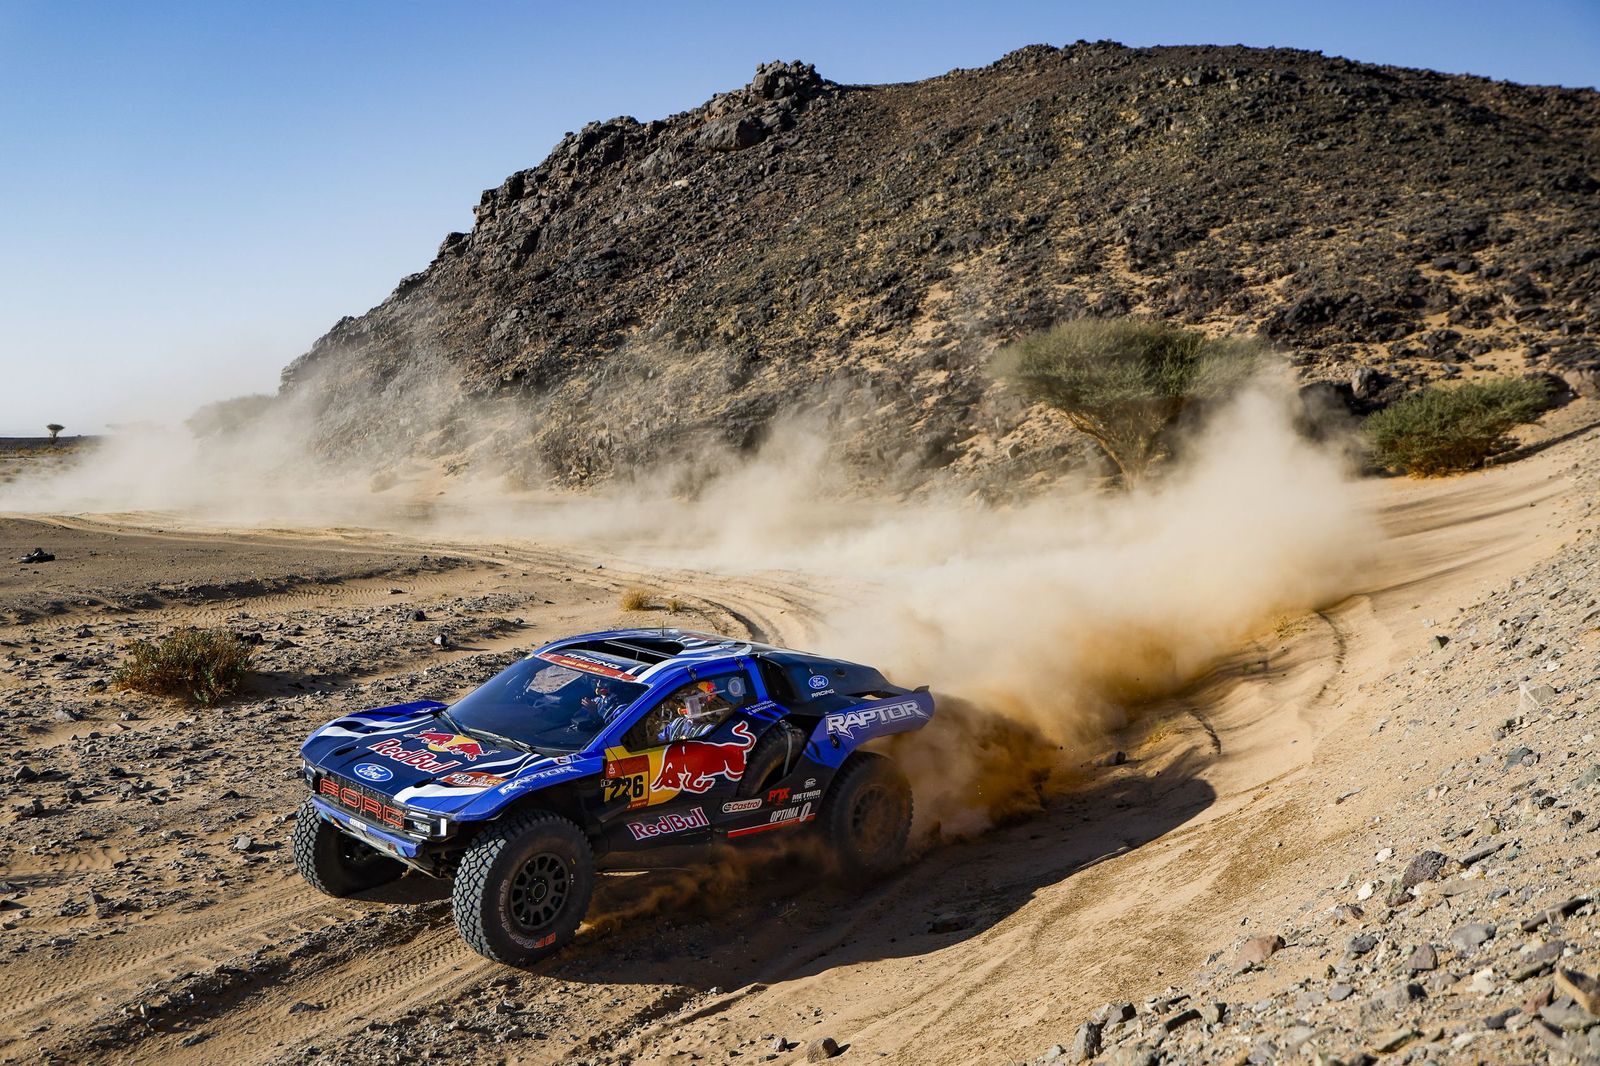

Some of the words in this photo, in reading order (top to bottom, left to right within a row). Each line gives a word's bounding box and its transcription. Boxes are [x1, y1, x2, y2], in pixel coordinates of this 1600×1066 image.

[564, 653, 623, 669] RACING
[811, 689, 835, 697] RACING
[825, 700, 930, 740] RAPTOR
[498, 765, 583, 796] RAPTOR
[609, 775, 644, 800] 226
[767, 787, 792, 804] FOX
[792, 789, 822, 801] METHOD
[320, 779, 405, 830] FORD
[731, 800, 760, 811] Castrol
[769, 806, 800, 823] OPTIMA
